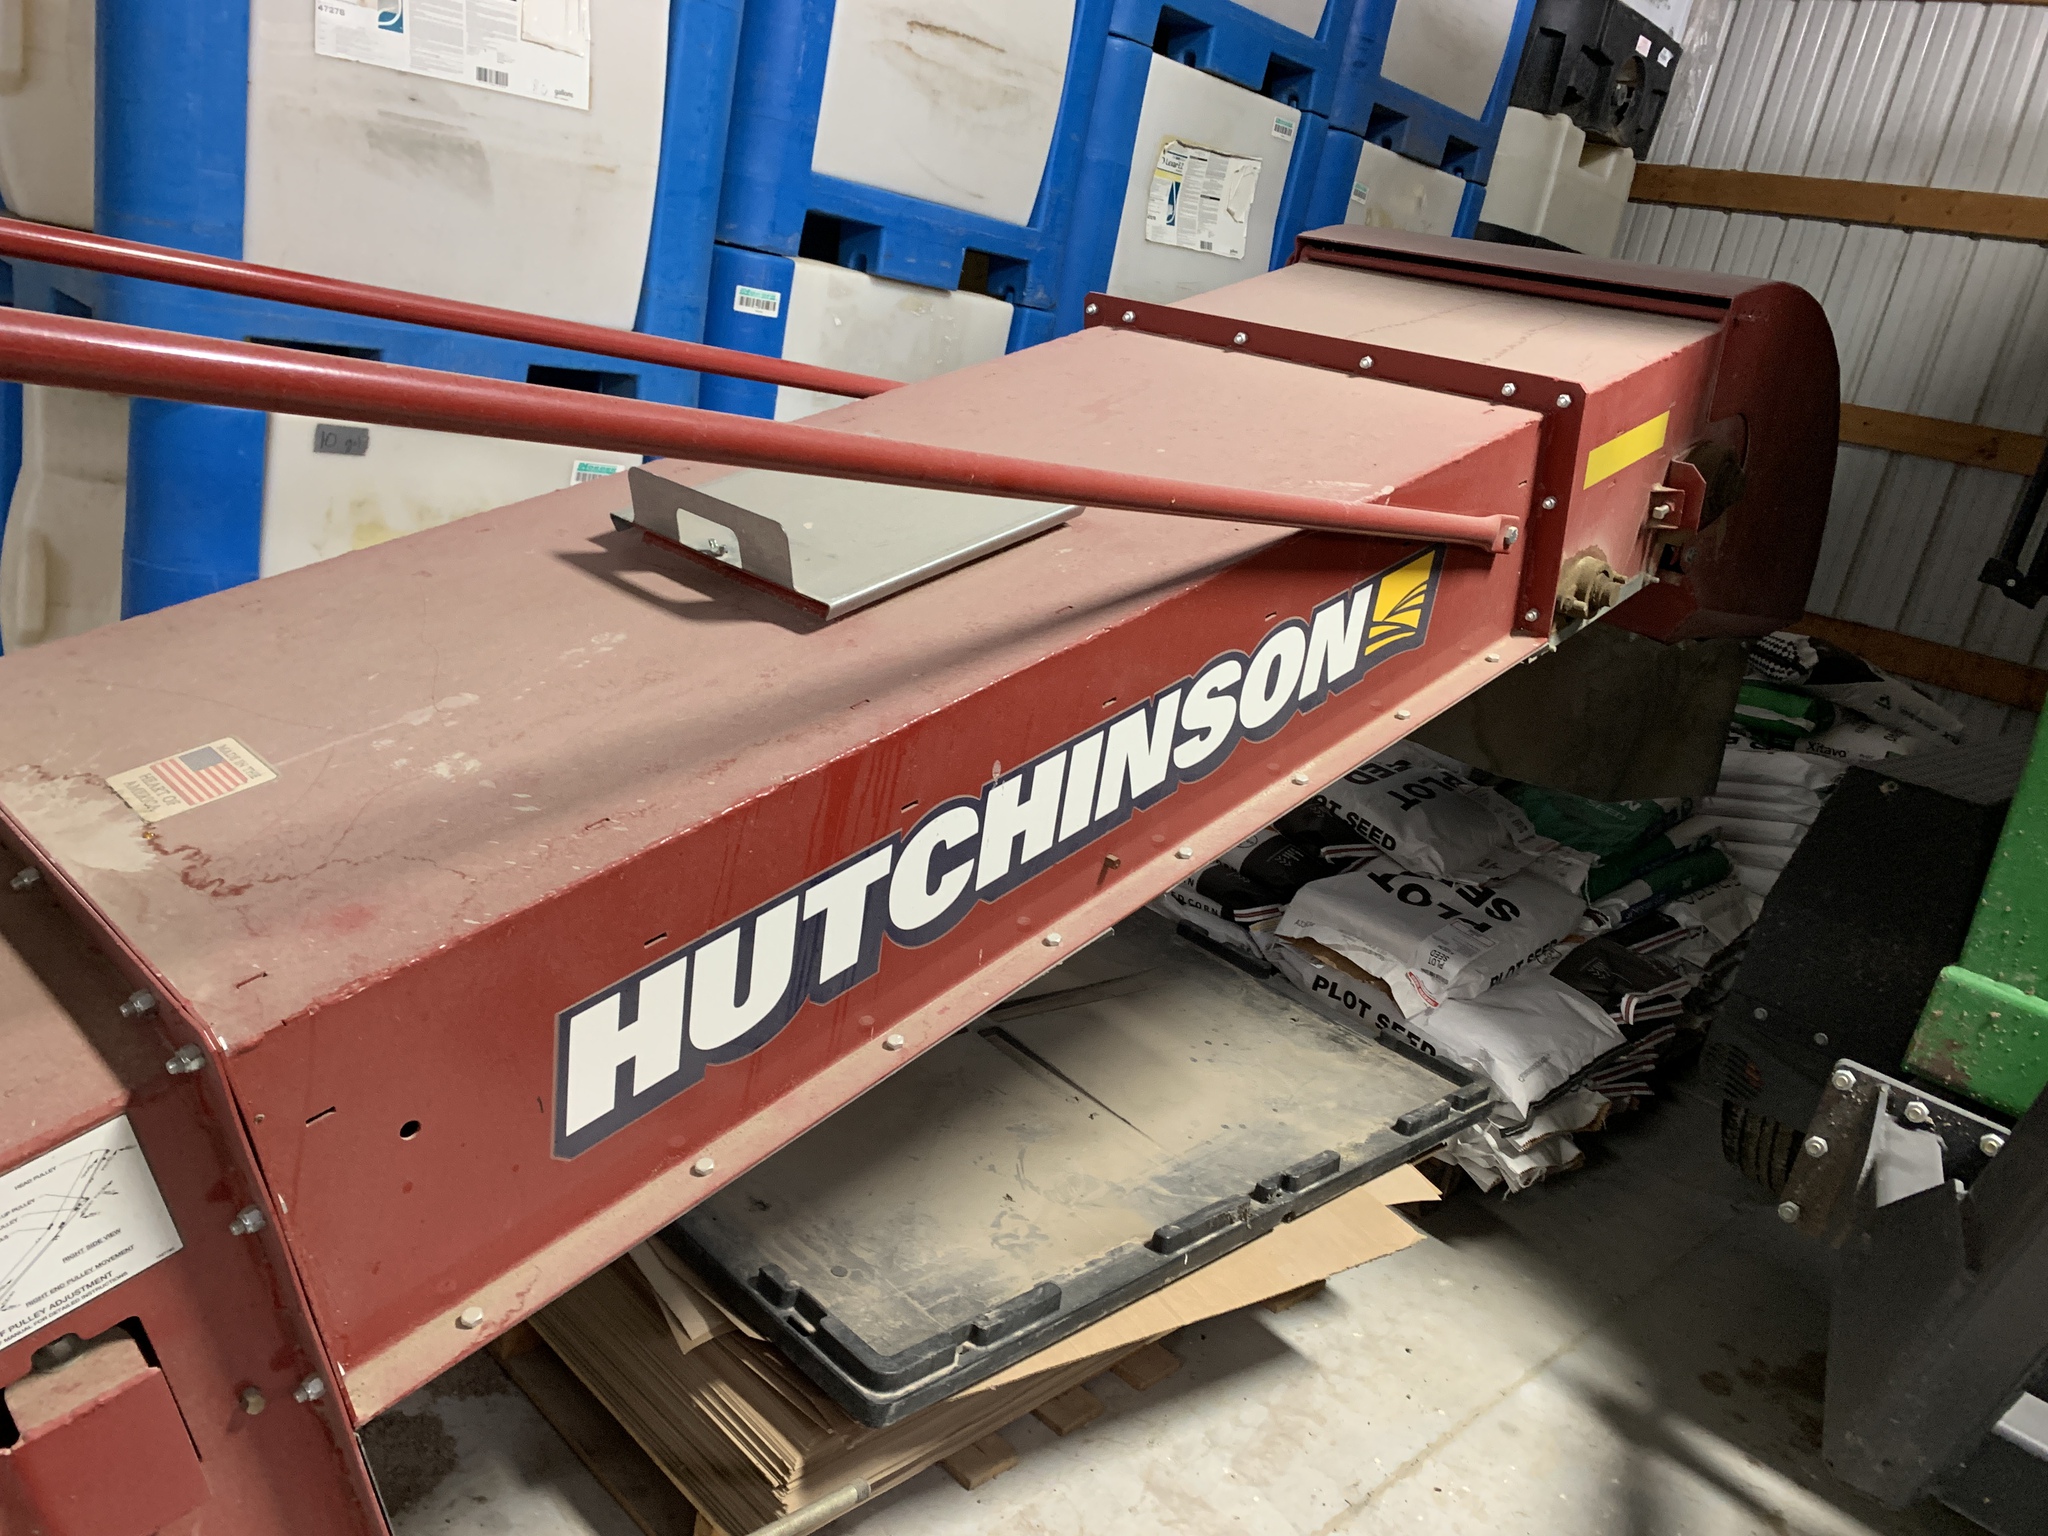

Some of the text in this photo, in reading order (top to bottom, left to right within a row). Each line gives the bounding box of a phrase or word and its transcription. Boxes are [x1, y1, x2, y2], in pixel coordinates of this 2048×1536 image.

[217, 743, 237, 761] MADE
[1806, 740, 1847, 758] Xitavo
[123, 780, 162, 812] AMERICA
[140, 773, 181, 806] HEART OF
[1346, 811, 1397, 851] SEED
[565, 586, 1373, 1138] HUTCHINSON
[1188, 898, 1220, 916] CORN
[1311, 974, 1373, 1019] PLOT
[14, 1165, 57, 1191] HEAD PULLEY
[11, 1198, 36, 1213] PULLEY
[62, 1227, 122, 1264] RIGHT SIDE VIEW
[25, 1291, 49, 1308] RIGHT
[49, 1281, 66, 1295] END
[66, 1268, 95, 1288] PULLEY
[95, 1244, 135, 1270] MOVEMENT
[3, 1271, 129, 1343] MANUAL FOR DETAILED INSTRUCTIONS
[8, 1307, 46, 1333] PULLEY
[49, 1270, 114, 1310] ADJUSTMENT
